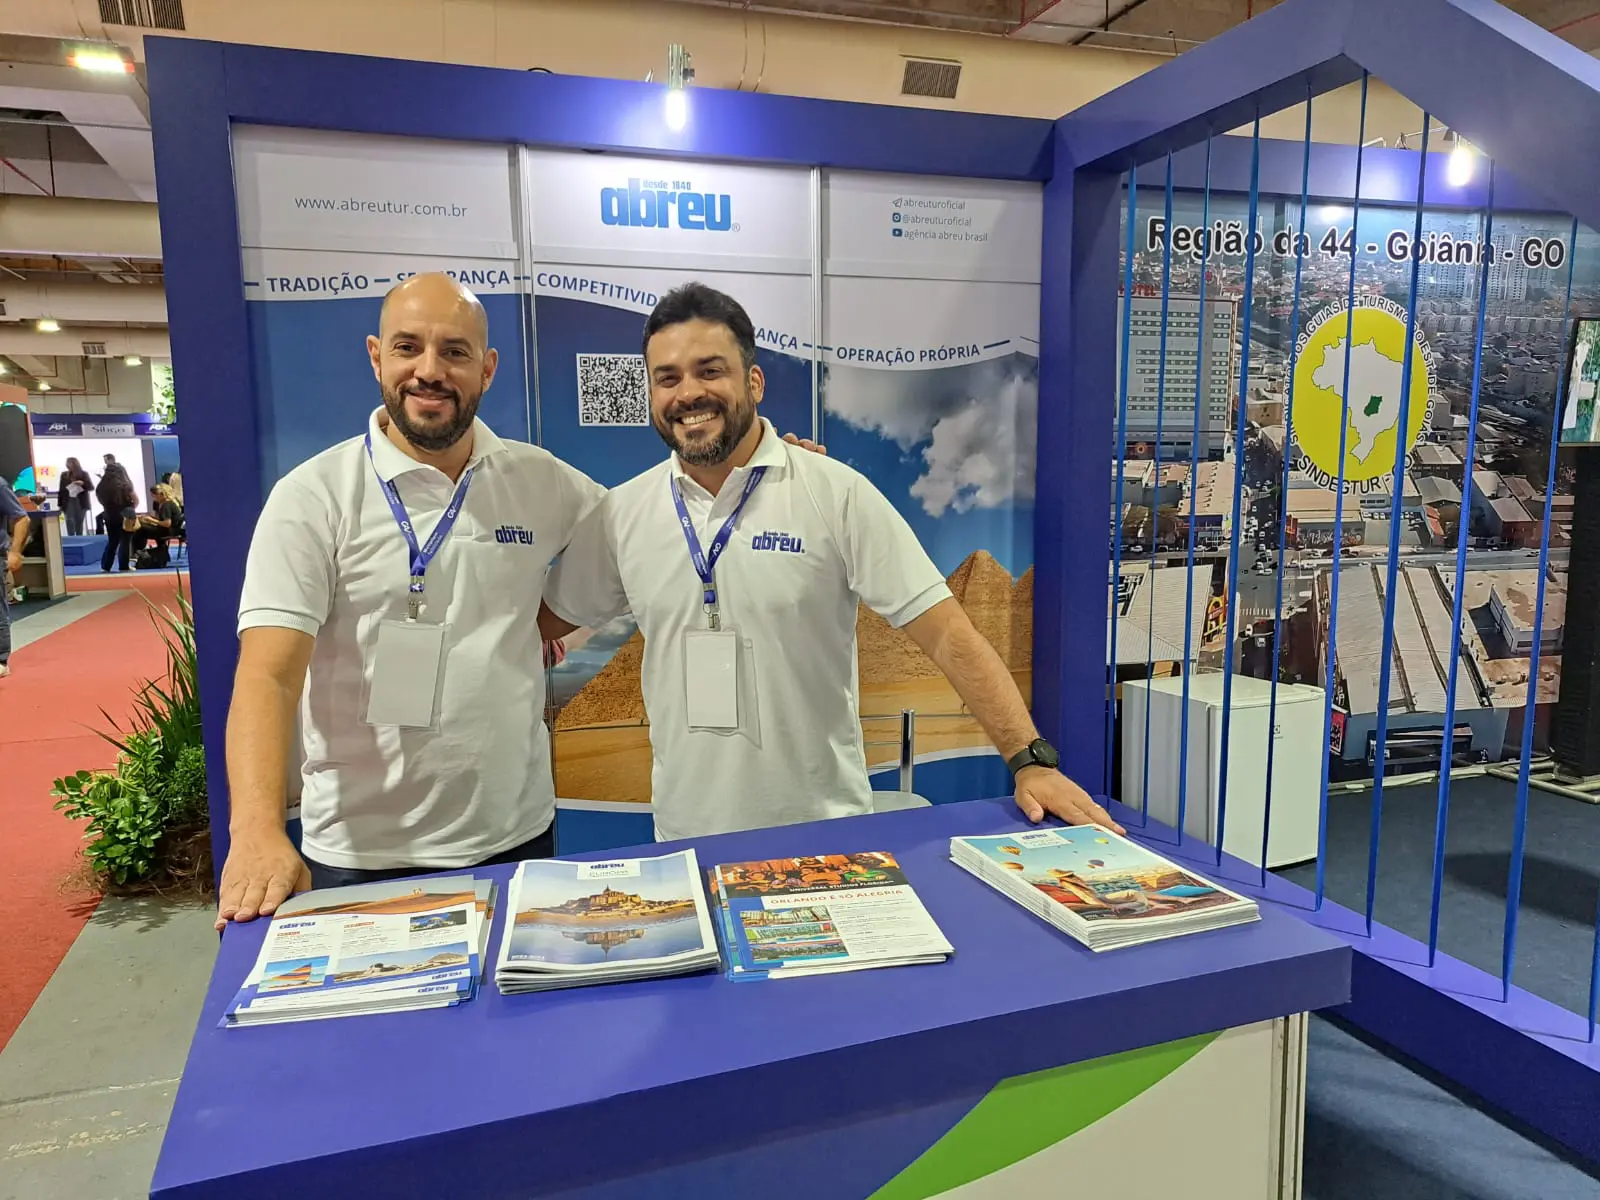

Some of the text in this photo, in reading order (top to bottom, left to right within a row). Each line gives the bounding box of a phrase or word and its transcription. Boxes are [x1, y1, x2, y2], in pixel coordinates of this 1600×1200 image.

[294, 197, 468, 217] www.abreutur.com.br
[600, 177, 732, 232] abreu
[903, 198, 966, 210] abreuturoficial
[902, 214, 972, 227] @abreuturoficial
[904, 229, 988, 242] agência abreu brasil
[1149, 217, 1262, 260] Região
[1275, 224, 1309, 256] da
[1321, 228, 1358, 258] 44
[1388, 231, 1494, 265] Goiânia
[1524, 238, 1564, 268] GO
[266, 272, 369, 296] TRADIÇÃO
[537, 272, 658, 307] COMPETITIVID
[836, 343, 981, 366] OPERAÇÃO PRÓPRIA
[1307, 300, 1343, 333] GUIAS
[1428, 375, 1437, 395] DE
[1299, 455, 1381, 495] SINDEGTUR
[495, 525, 533, 545] abreu
[752, 531, 802, 553] abreu
[770, 896, 826, 905] ORLANDO
[856, 889, 903, 898] ALEGRIA
